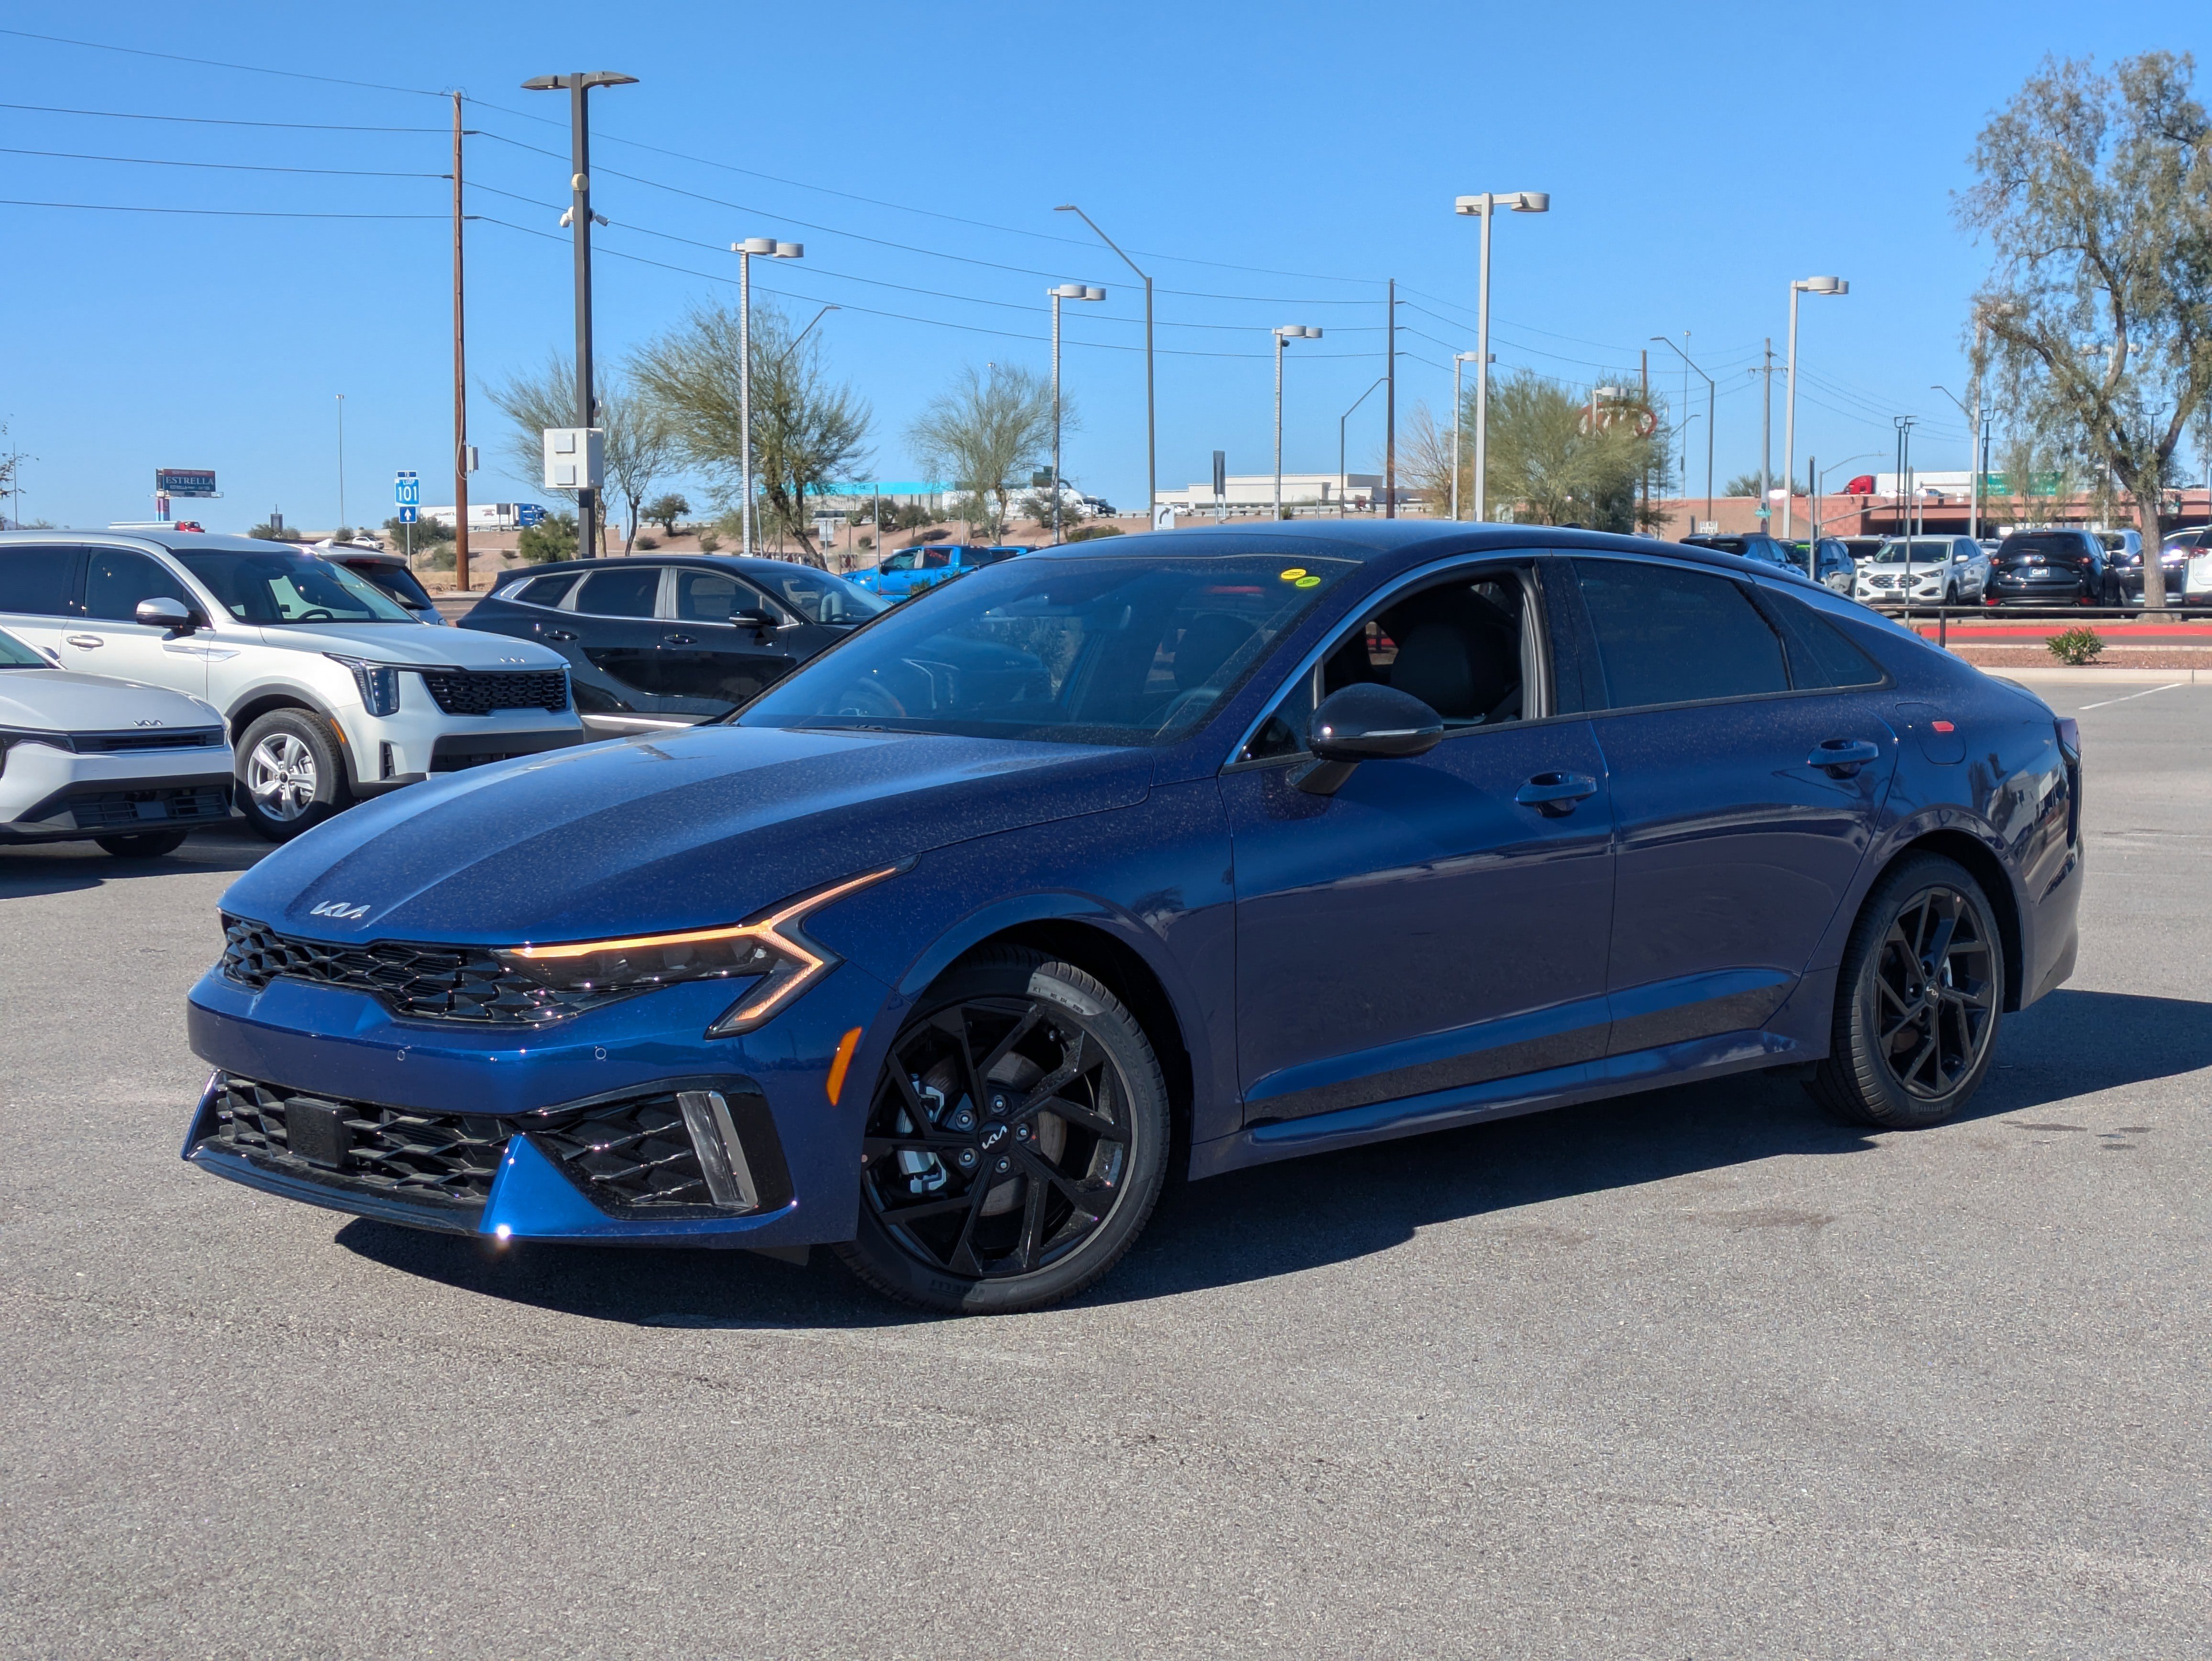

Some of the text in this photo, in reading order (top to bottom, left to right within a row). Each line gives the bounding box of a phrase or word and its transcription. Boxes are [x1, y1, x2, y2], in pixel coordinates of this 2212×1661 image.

[166, 476, 214, 485] ESTRELLA
[398, 486, 417, 501] 101
[310, 900, 371, 919] KIA
[982, 1125, 1007, 1149] KIA
